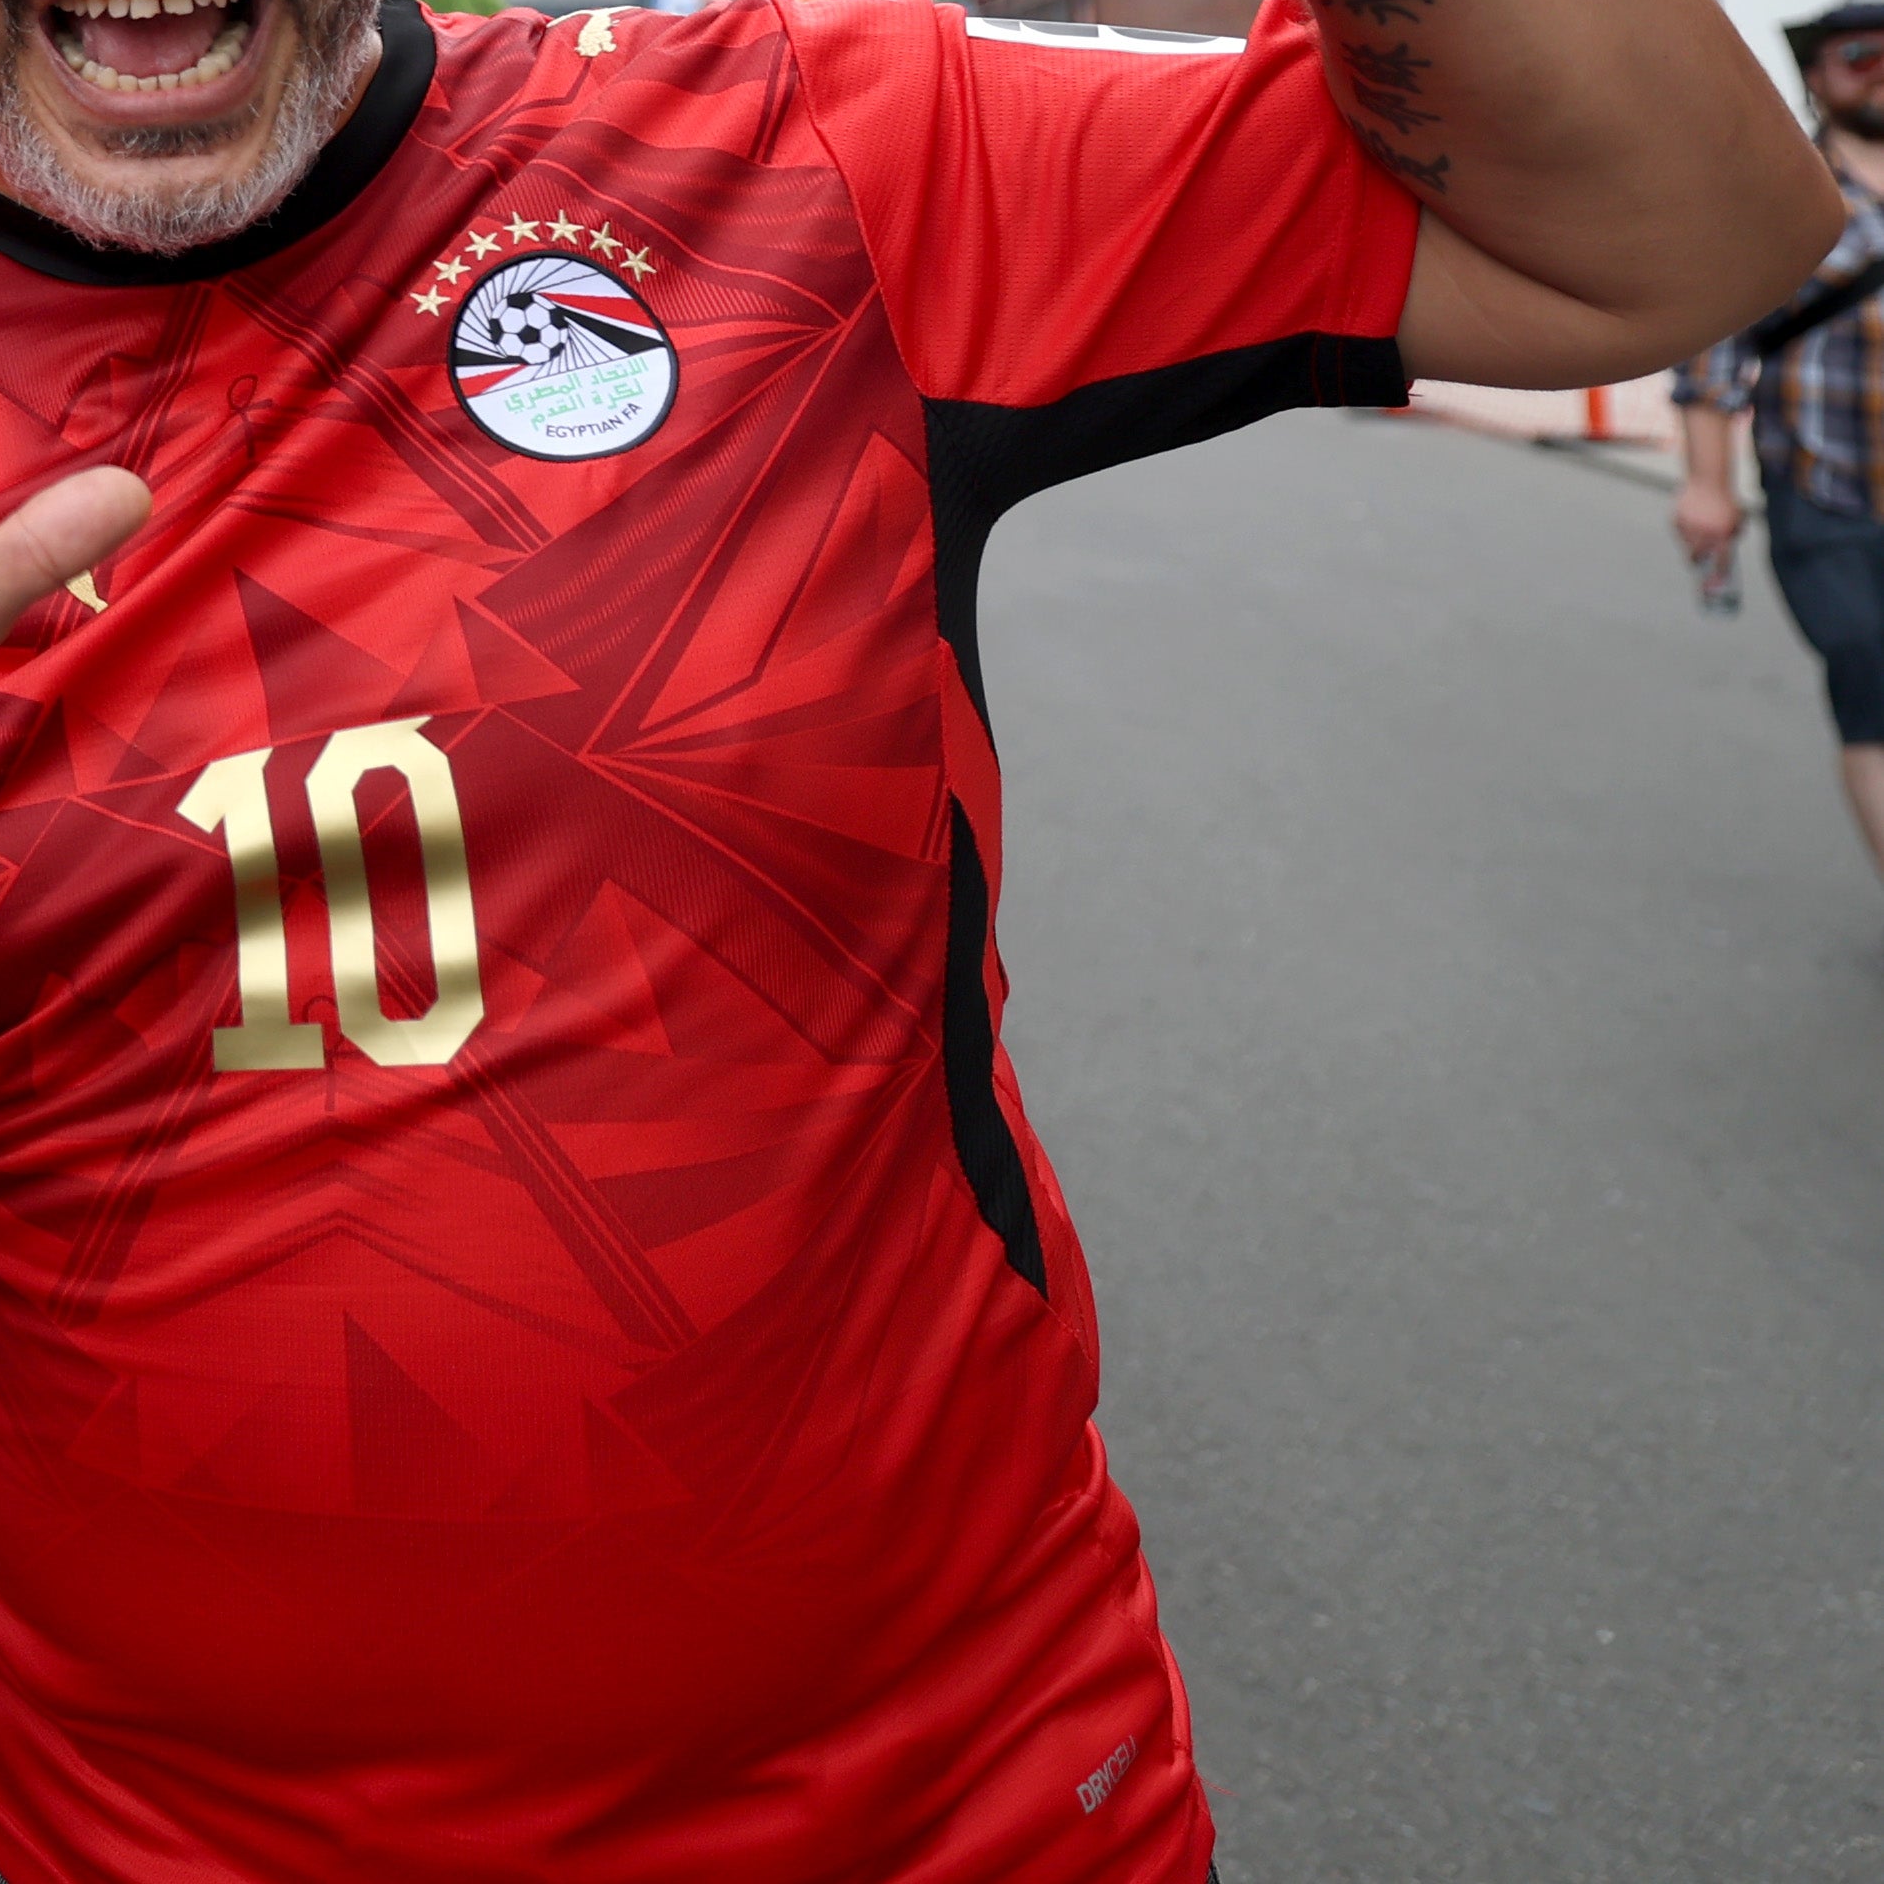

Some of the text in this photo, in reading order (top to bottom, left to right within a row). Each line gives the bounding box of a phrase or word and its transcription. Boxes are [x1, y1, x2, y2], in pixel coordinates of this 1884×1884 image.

[545, 402, 642, 438] EGYPTIAN FA
[175, 714, 485, 1073] 10
